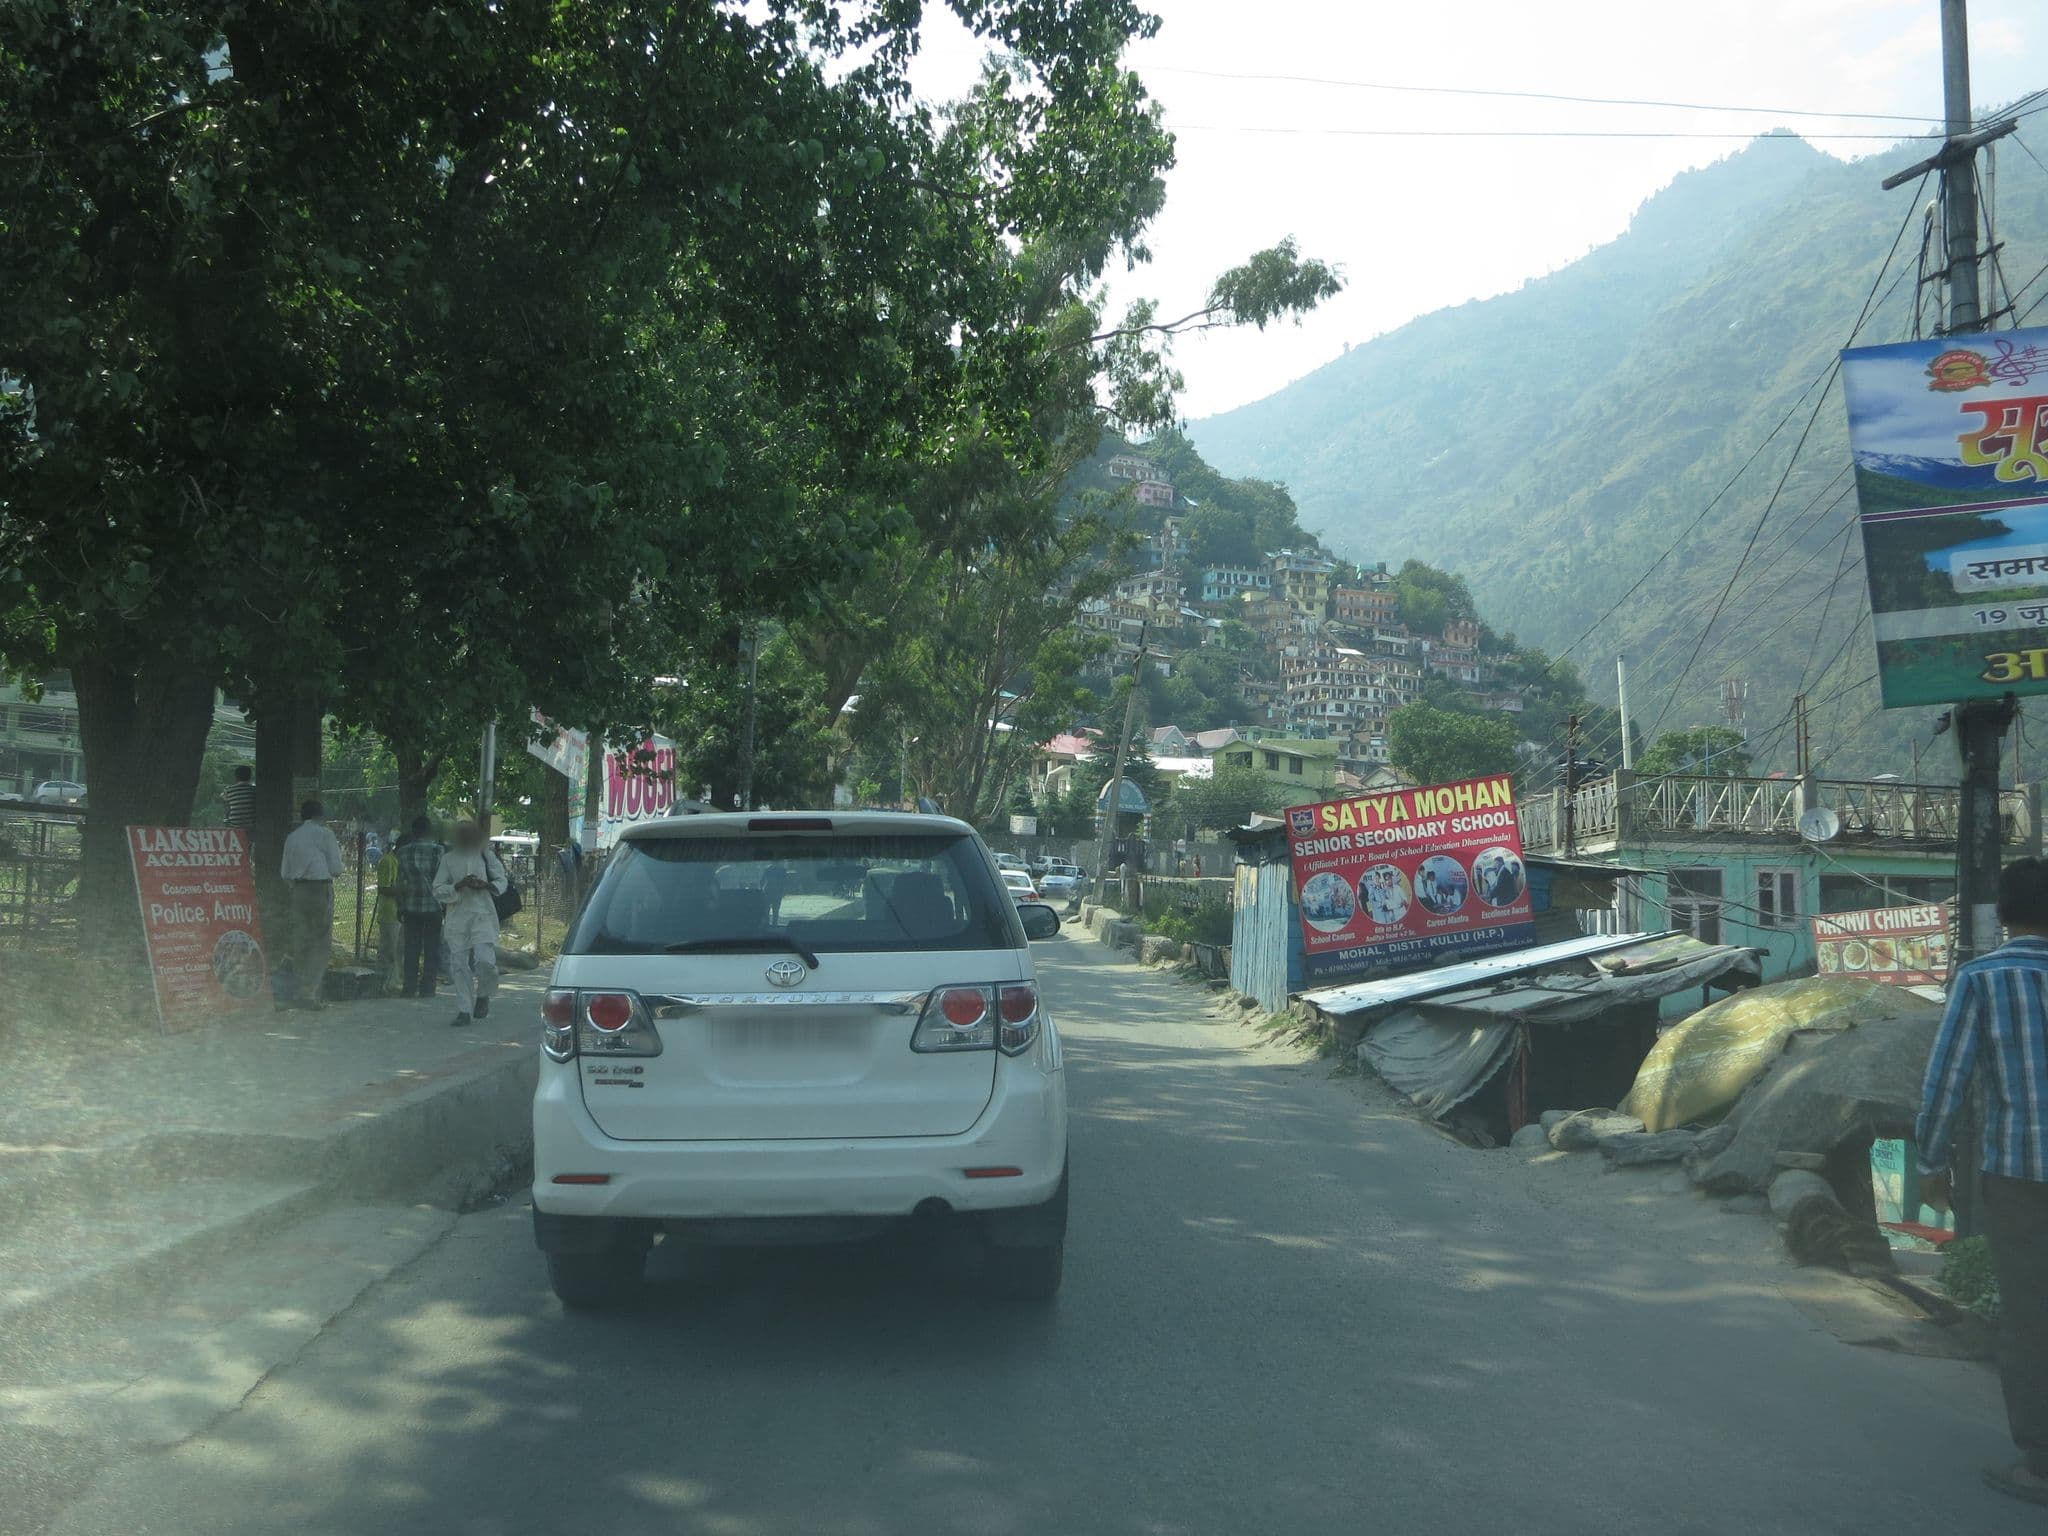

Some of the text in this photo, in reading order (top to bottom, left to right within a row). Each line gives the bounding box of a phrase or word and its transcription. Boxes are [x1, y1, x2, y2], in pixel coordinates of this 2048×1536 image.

[1974, 605, 2048, 625] 19 जू
[1982, 648, 2048, 683] अ
[1321, 778, 1512, 833] SATYA MOHAN
[137, 828, 243, 852] LAKSHYA
[1294, 811, 1515, 857] SENIOR SECONDARY SCHOOL
[144, 853, 242, 867] ACADEMY
[1303, 832, 1511, 872] (Affiliated To H.P. Board of School Education Dharamshala)
[150, 900, 252, 927] Police, Army
[1426, 914, 1469, 928] Career Mantra
[1481, 904, 1529, 920] Excellence Award
[1873, 905, 1941, 932] CHINESE
[1310, 931, 1356, 945] School Campus
[1339, 927, 1505, 960] MOHAL, DISTT. KULLU (H.P.)
[696, 993, 875, 1005] FORTUNER
